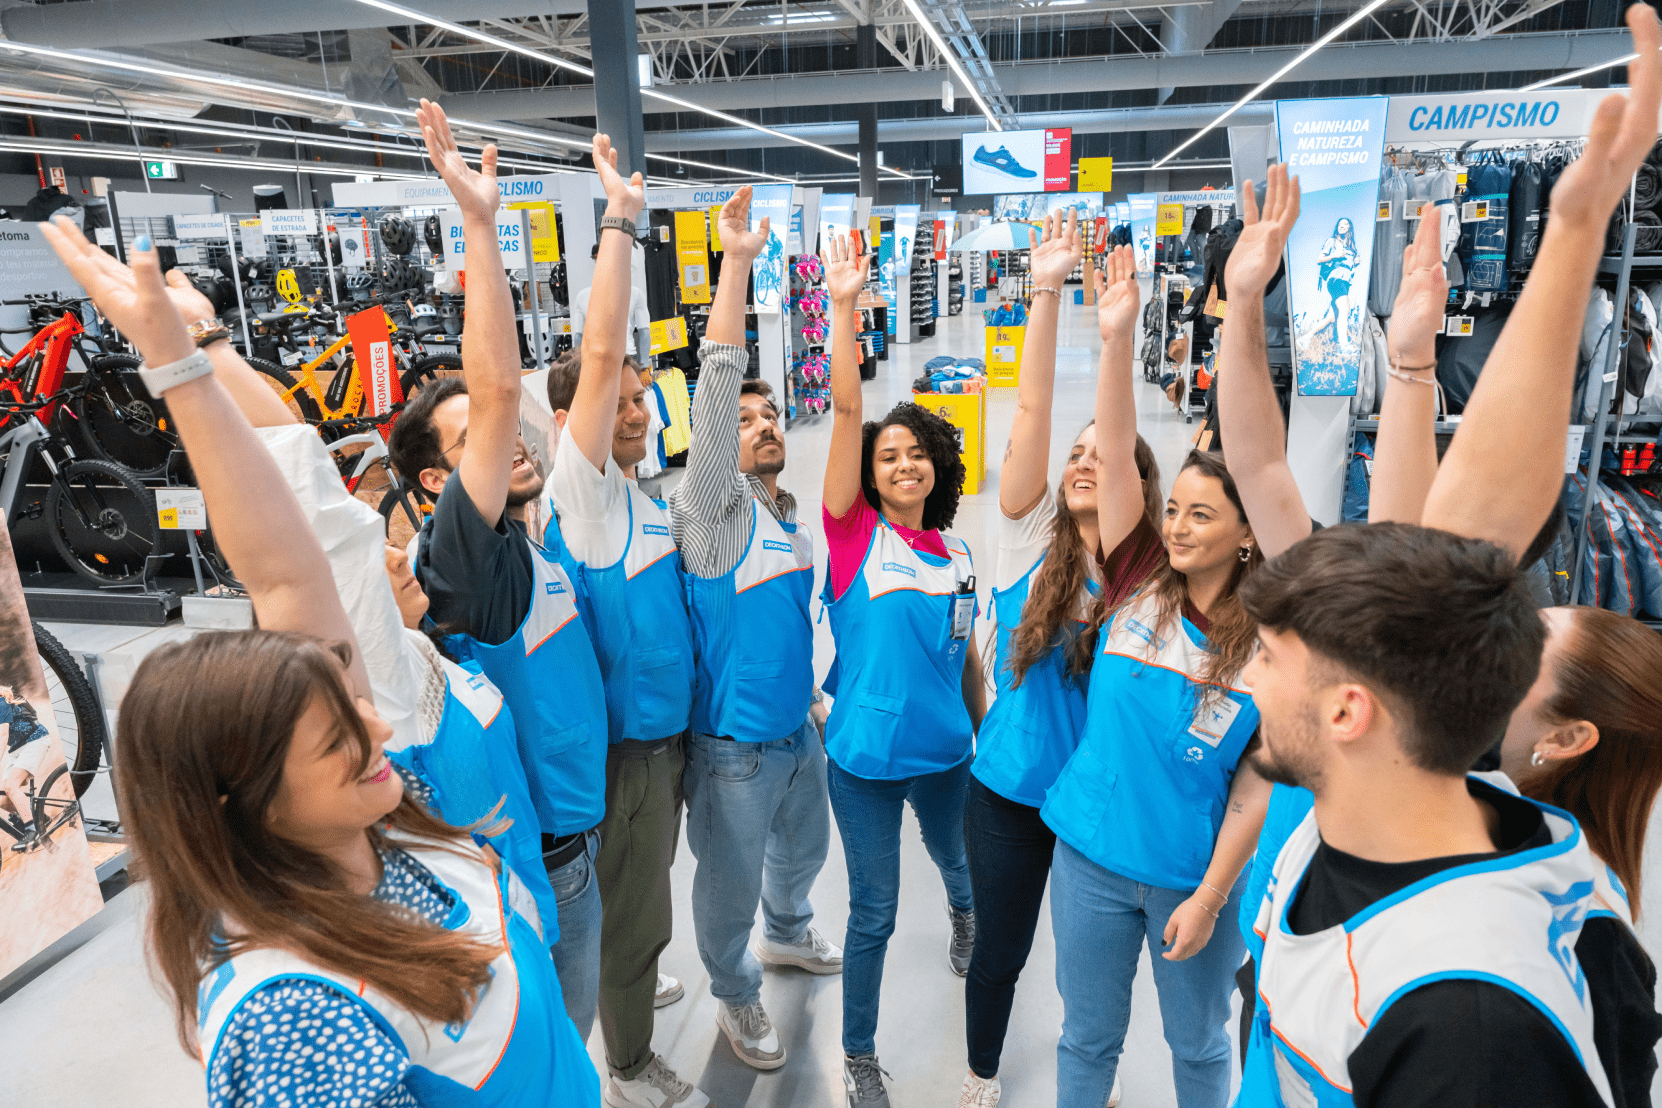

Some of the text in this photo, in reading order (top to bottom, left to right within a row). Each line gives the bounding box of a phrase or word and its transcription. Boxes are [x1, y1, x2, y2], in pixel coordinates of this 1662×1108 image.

[1408, 101, 1560, 131] CAMPISMO
[1293, 119, 1370, 134] CAMINHADA
[1297, 135, 1363, 150] NATUREZA
[1288, 151, 1369, 167] E CAMPISMO
[404, 187, 449, 198] EQUIPAMEN
[497, 180, 543, 196] CLISMO
[693, 190, 734, 203] CICLISM
[1163, 193, 1235, 202] CAMINHADA NATUR
[272, 215, 305, 223] CAPACETES
[450, 224, 520, 238] BITAS
[0, 249, 48, 257] ompramos
[374, 347, 387, 415] PROMOÇÕES
[764, 541, 792, 550] DECATHLON
[884, 563, 915, 575] DECATHLON
